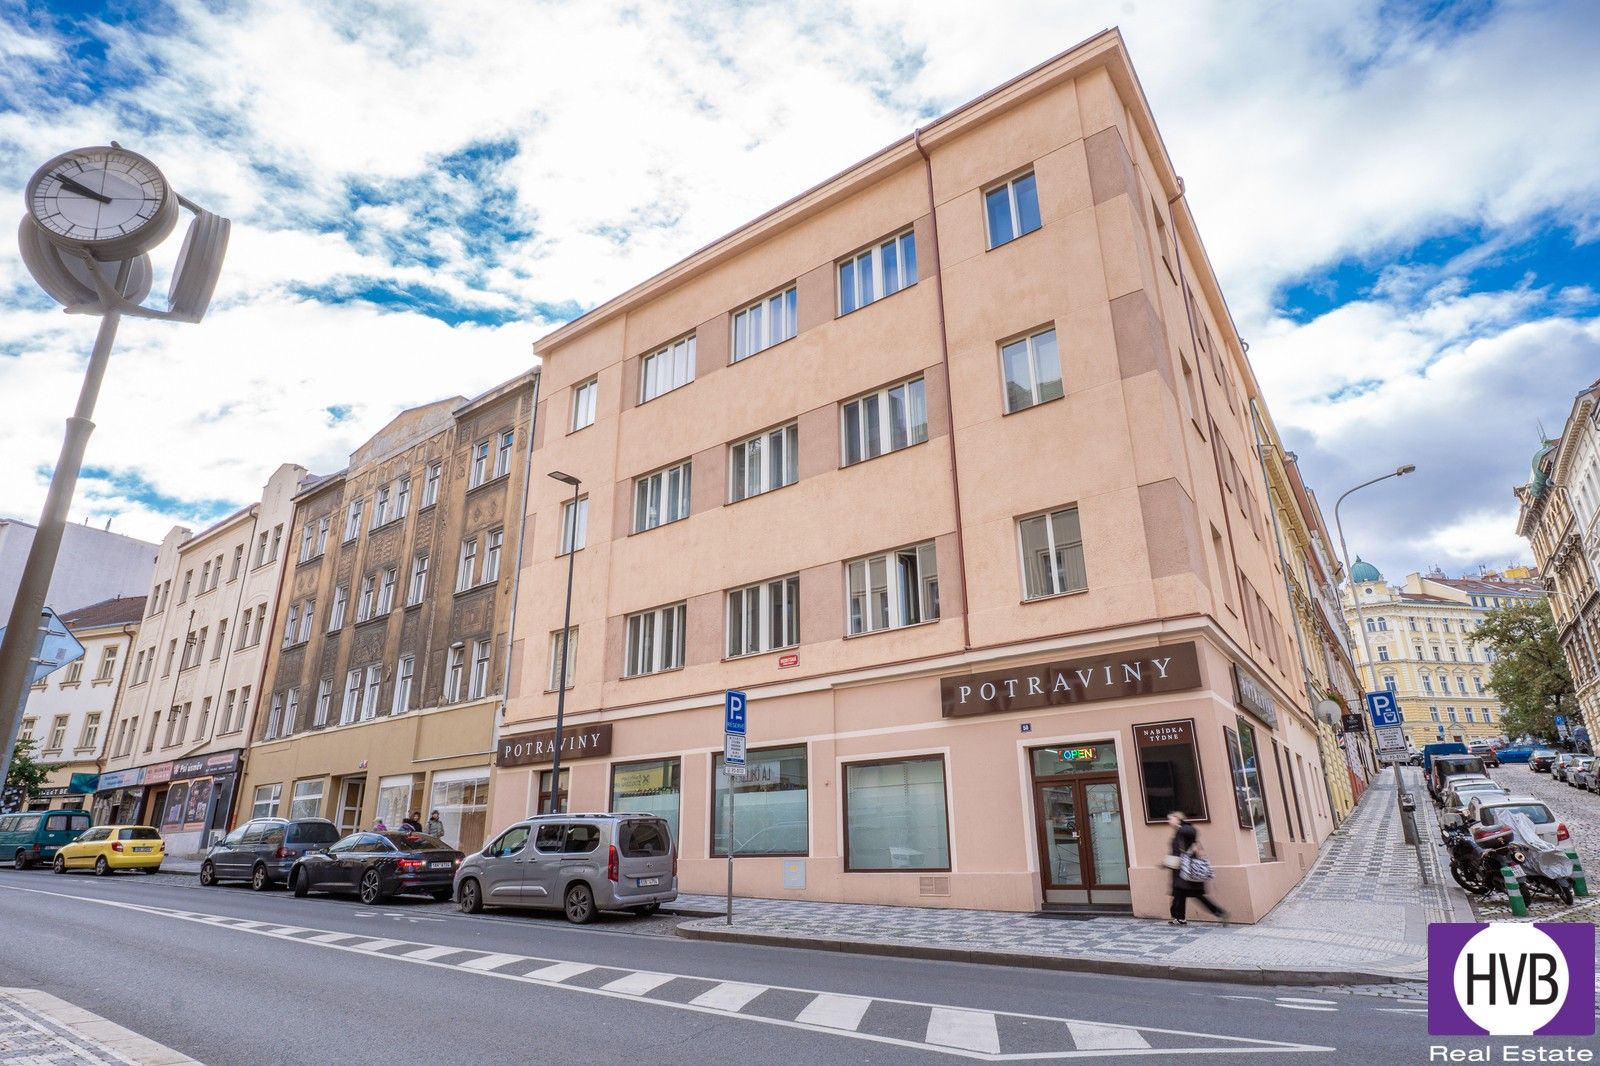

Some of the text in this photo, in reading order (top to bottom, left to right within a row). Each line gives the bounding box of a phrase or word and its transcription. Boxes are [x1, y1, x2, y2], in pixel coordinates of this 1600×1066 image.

[958, 657, 1172, 704] POTRAVINY
[730, 696, 743, 719] P
[1373, 696, 1390, 716] P
[1143, 727, 1184, 736] NABÍDKA
[1063, 748, 1093, 760] OPEN
